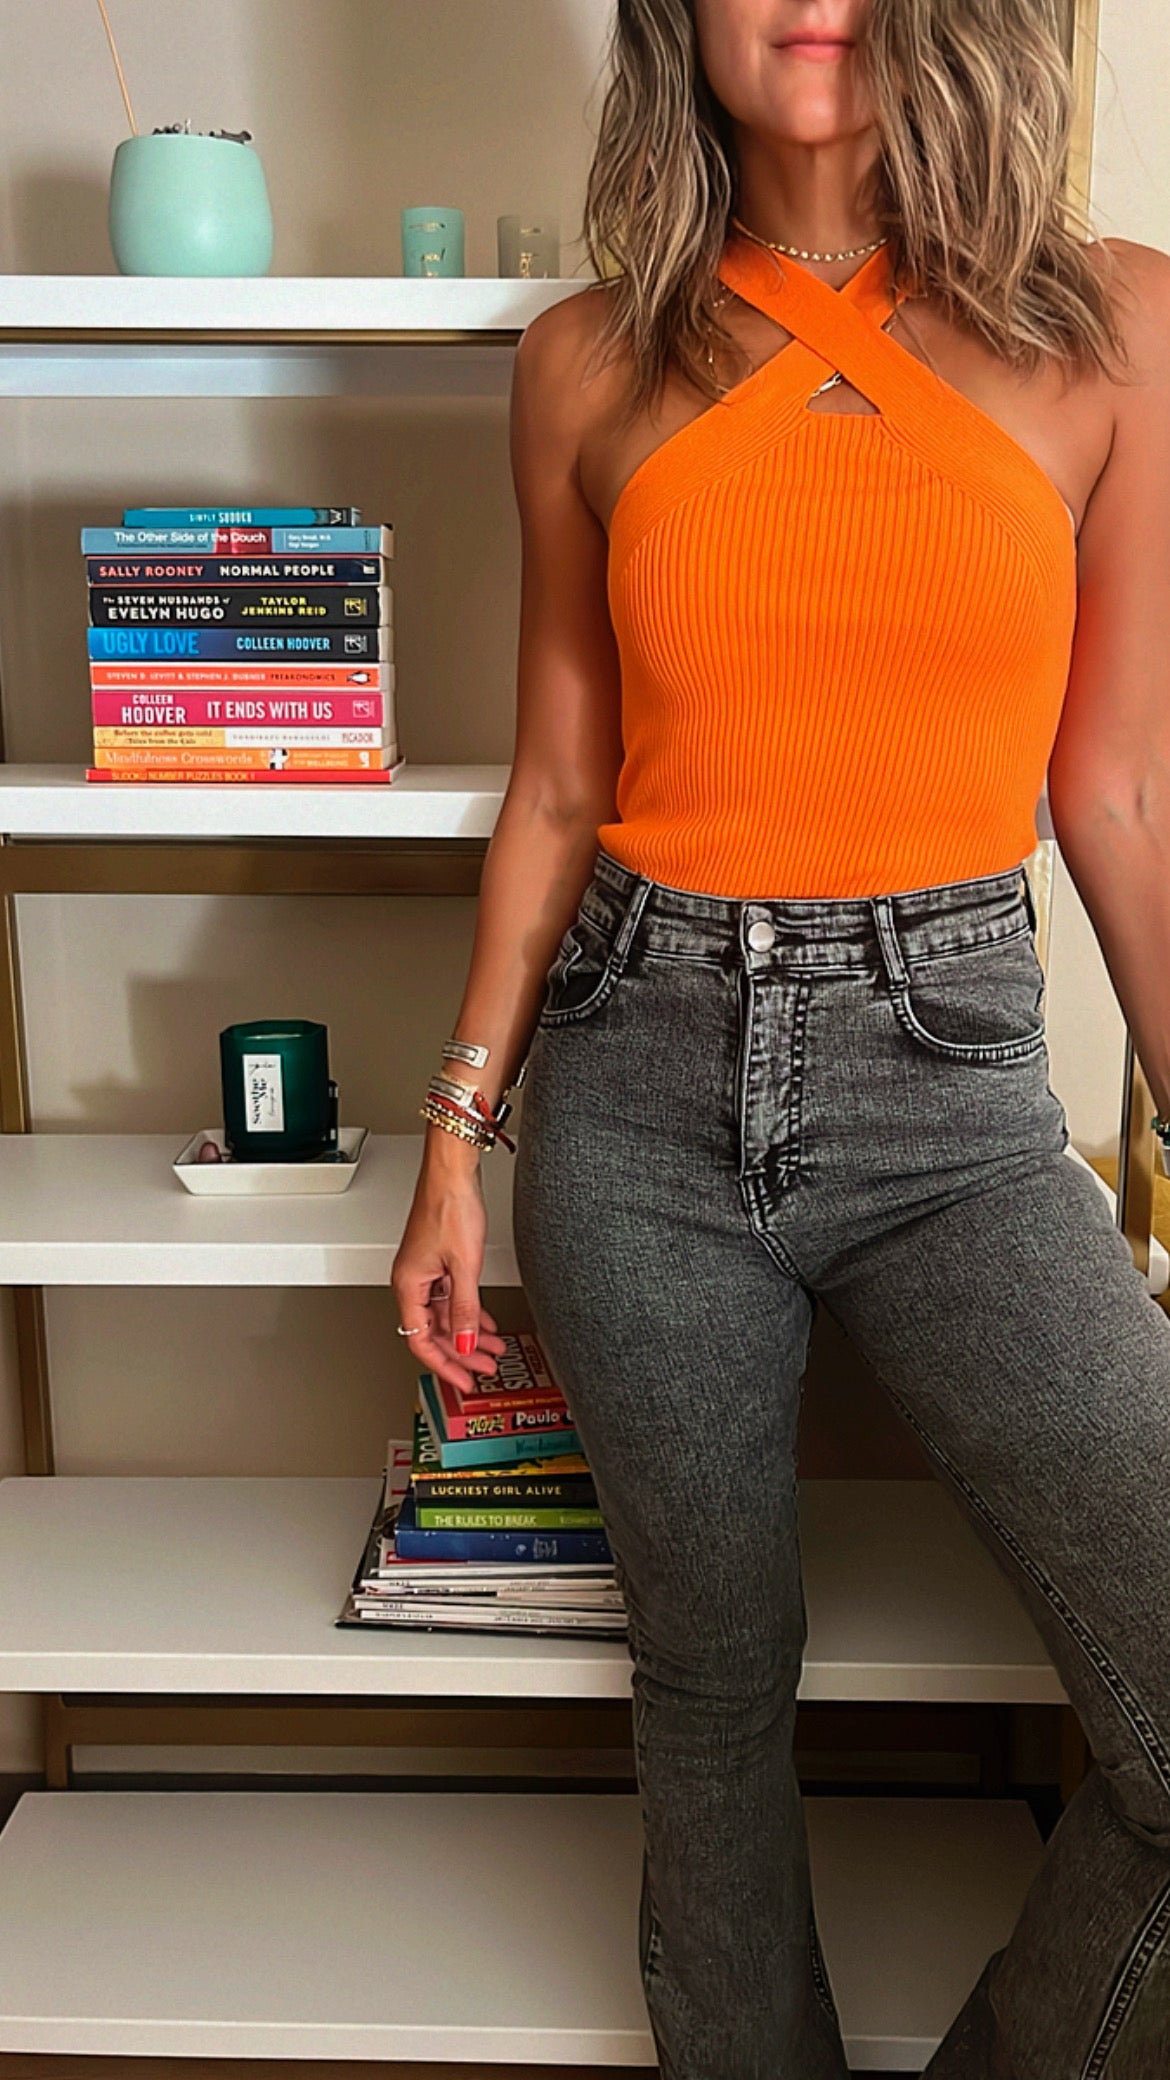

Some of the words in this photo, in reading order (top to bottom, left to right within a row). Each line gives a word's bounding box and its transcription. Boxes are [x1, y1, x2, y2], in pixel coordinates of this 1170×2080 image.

[114, 531, 135, 543] The
[138, 531, 168, 543] Other
[170, 531, 195, 543] Side
[197, 531, 209, 543] of
[211, 531, 229, 543] the
[99, 566, 140, 577] SALLY
[145, 566, 203, 577] ROONEY
[220, 565, 280, 576] NORMAL
[283, 565, 335, 576] PEOPLE
[117, 595, 155, 605] SEVEN
[159, 595, 220, 605] HUSBANDS
[260, 597, 307, 606] TAYLOR
[108, 607, 170, 620] EVELYN
[176, 607, 224, 620] HUGO
[241, 606, 294, 616] JENKINS
[298, 606, 327, 616] REID
[103, 631, 148, 654] UGLY
[154, 631, 200, 654] LOVE
[236, 637, 284, 650] COLLEEN
[287, 637, 331, 650] HOOVER
[107, 672, 137, 680] STEVEN
[150, 672, 176, 680] LEVITT
[178, 672, 184, 680] &
[187, 672, 222, 680] STEPHEN
[270, 673, 335, 681] FREAKONOMICS
[132, 694, 174, 705] COLLEEN
[121, 706, 187, 724] HOOVER
[206, 701, 221, 719] IT
[226, 701, 265, 719] ENDS
[269, 701, 308, 719] WITH
[312, 702, 333, 719] US
[342, 732, 373, 743] PICADOR
[105, 751, 178, 764] Mindfulness
[181, 751, 253, 764] Crosswords
[515, 1408, 560, 1426] Paulo
[431, 1485, 489, 1496] LUCKIEST
[493, 1485, 522, 1496] GIRL
[526, 1485, 562, 1496] ALIVE
[435, 1514, 453, 1526] THE
[455, 1514, 487, 1527] RULES
[489, 1515, 503, 1527] TO
[505, 1515, 537, 1527] BREAK
